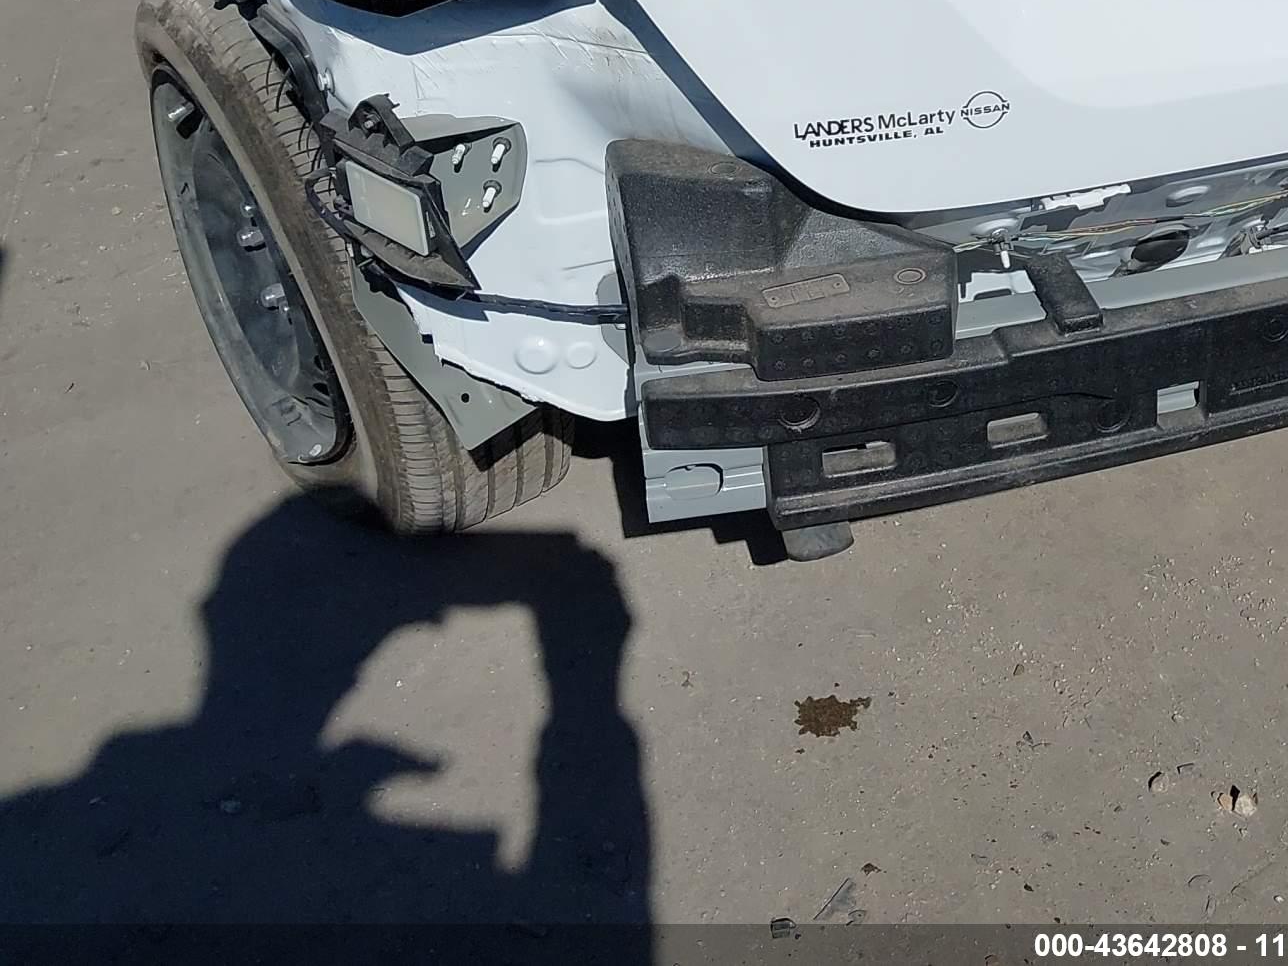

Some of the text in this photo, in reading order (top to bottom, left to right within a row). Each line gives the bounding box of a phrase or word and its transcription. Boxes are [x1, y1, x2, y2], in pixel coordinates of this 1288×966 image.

[794, 102, 1011, 141] LANDERS McLarty NISSAN
[809, 126, 944, 148] HUNTSVILLE, AL
